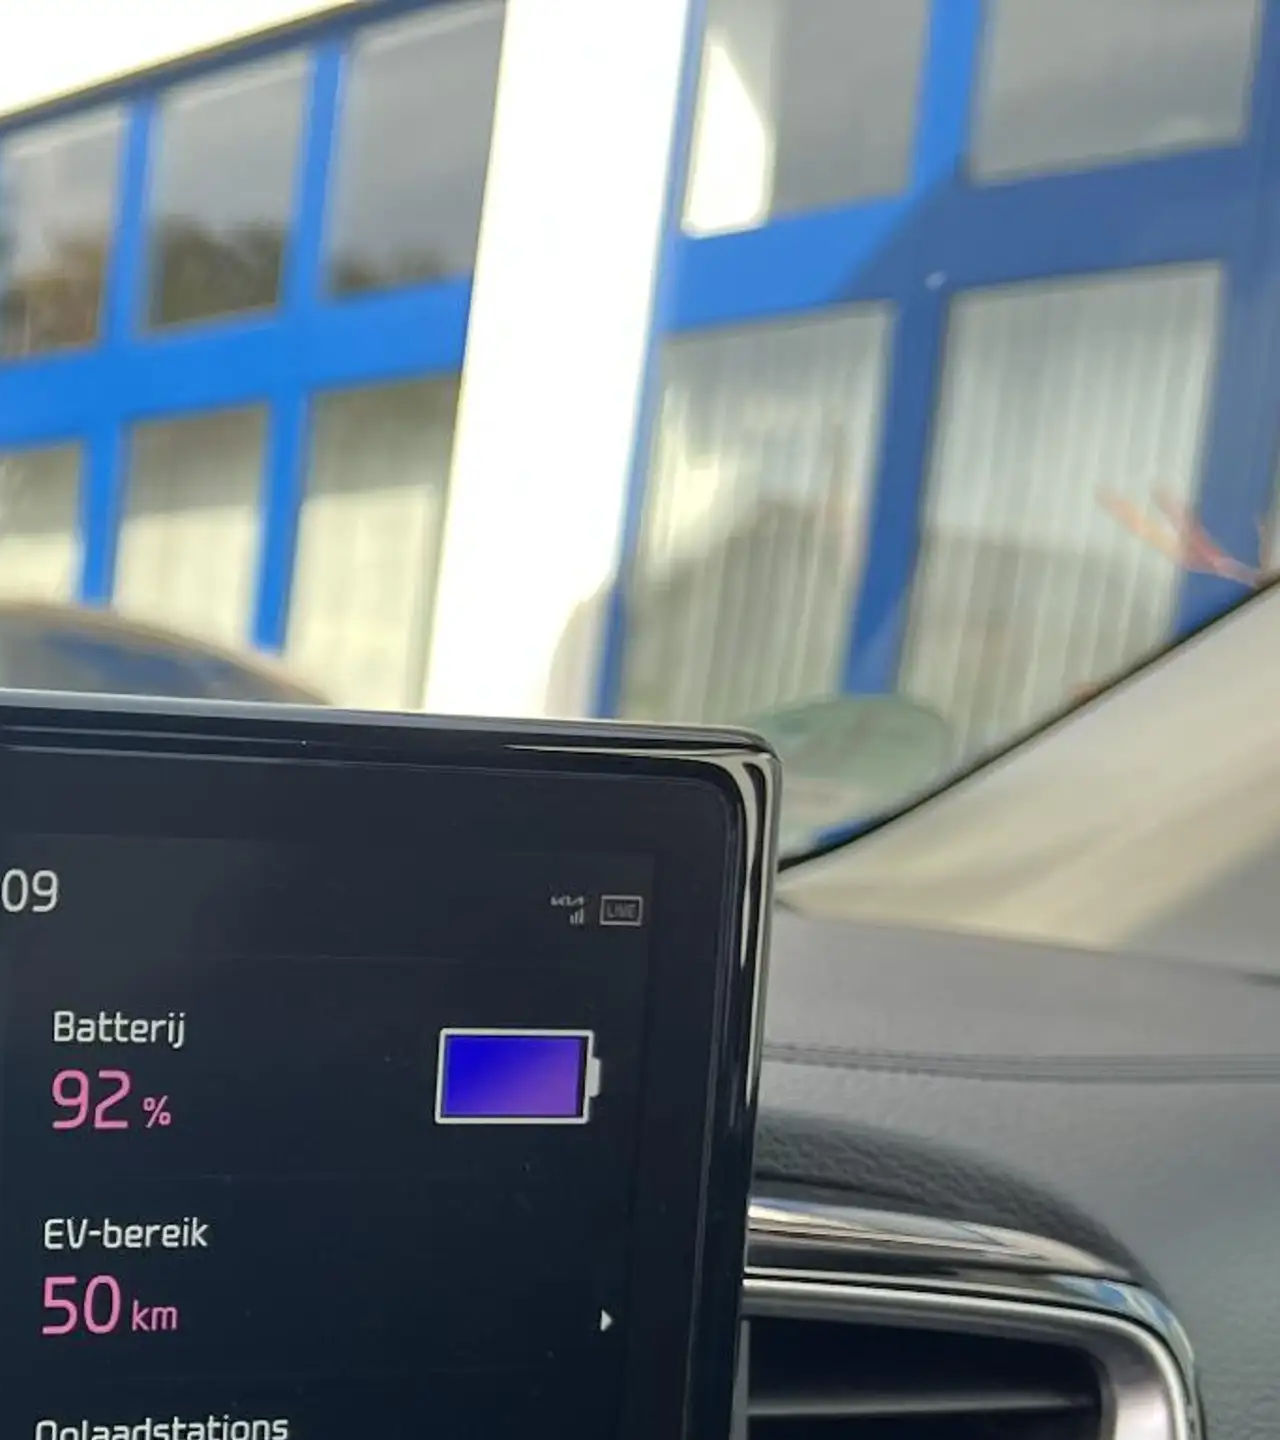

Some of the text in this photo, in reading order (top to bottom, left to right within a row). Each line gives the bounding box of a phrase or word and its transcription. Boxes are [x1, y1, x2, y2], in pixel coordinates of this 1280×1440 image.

[53, 1010, 185, 1049] Batterij
[52, 1069, 171, 1129] 92 %
[44, 1216, 208, 1250] EV-bereik
[42, 1275, 178, 1335] 50 km
